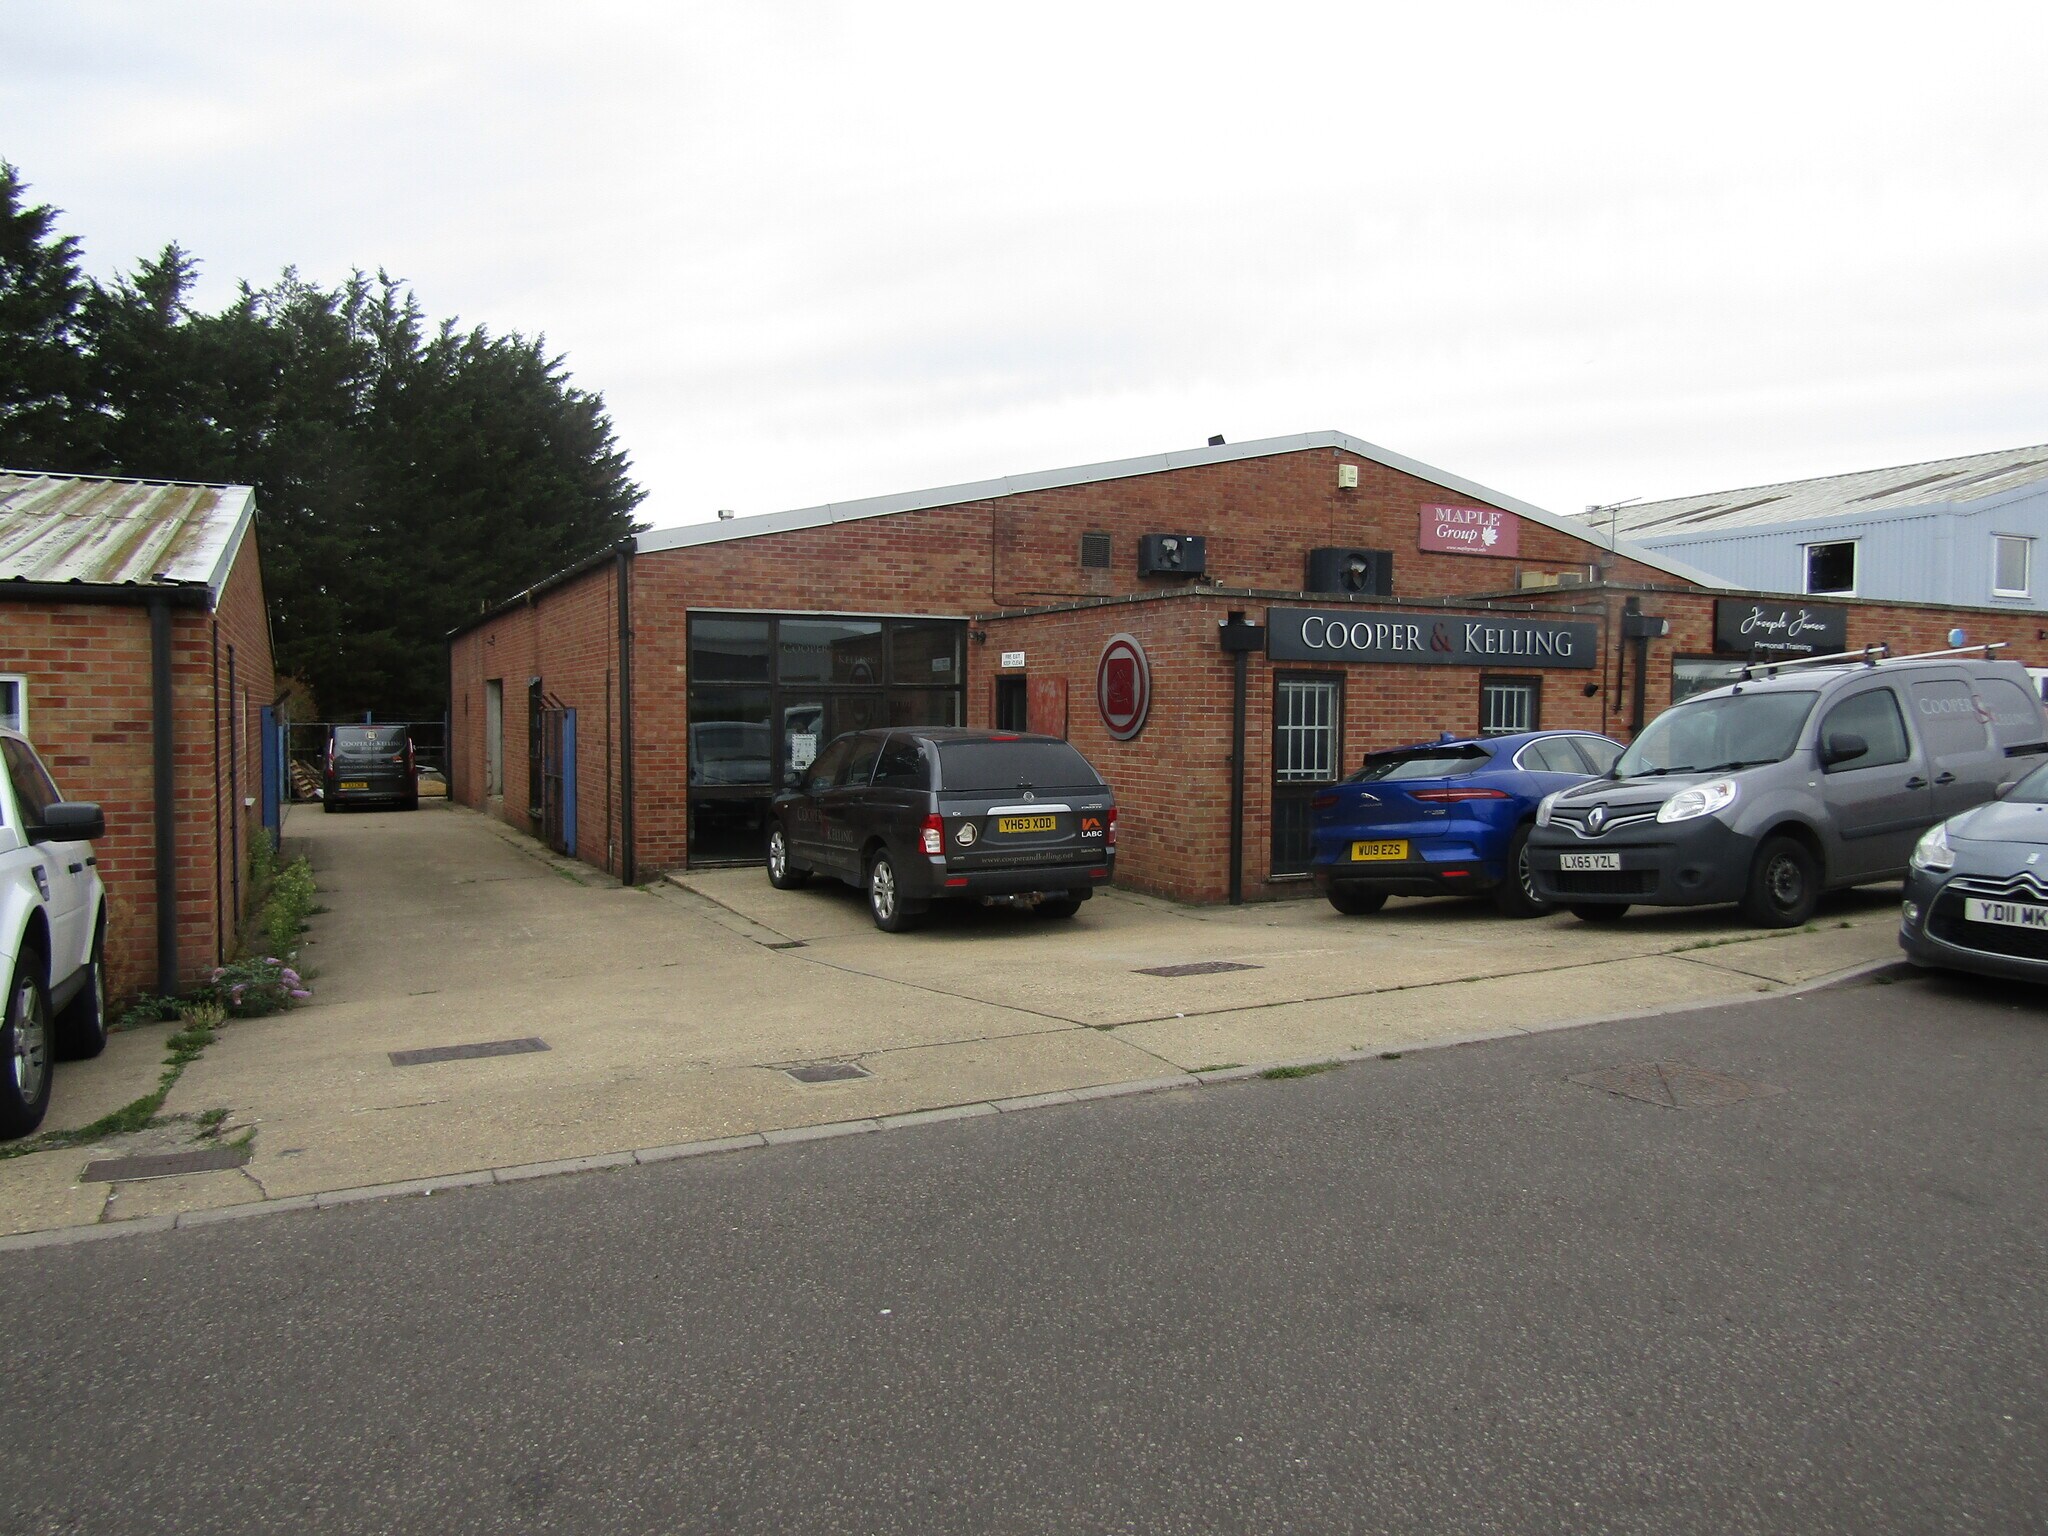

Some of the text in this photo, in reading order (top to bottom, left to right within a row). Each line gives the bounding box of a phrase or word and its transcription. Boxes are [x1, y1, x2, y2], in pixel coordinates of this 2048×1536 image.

[1434, 507, 1502, 526] MAPLE
[1436, 524, 1478, 543] Group
[1740, 606, 1786, 634] Joseph
[1301, 616, 1573, 657] COOPER & KELLING
[1754, 641, 1812, 652] Personal Training
[1919, 698, 1975, 715] COOPER
[1004, 817, 1051, 830] YH63 XDD
[1081, 830, 1103, 838] LABC
[1381, 844, 1401, 855] EZS
[1564, 856, 1615, 869] LX65 YZL
